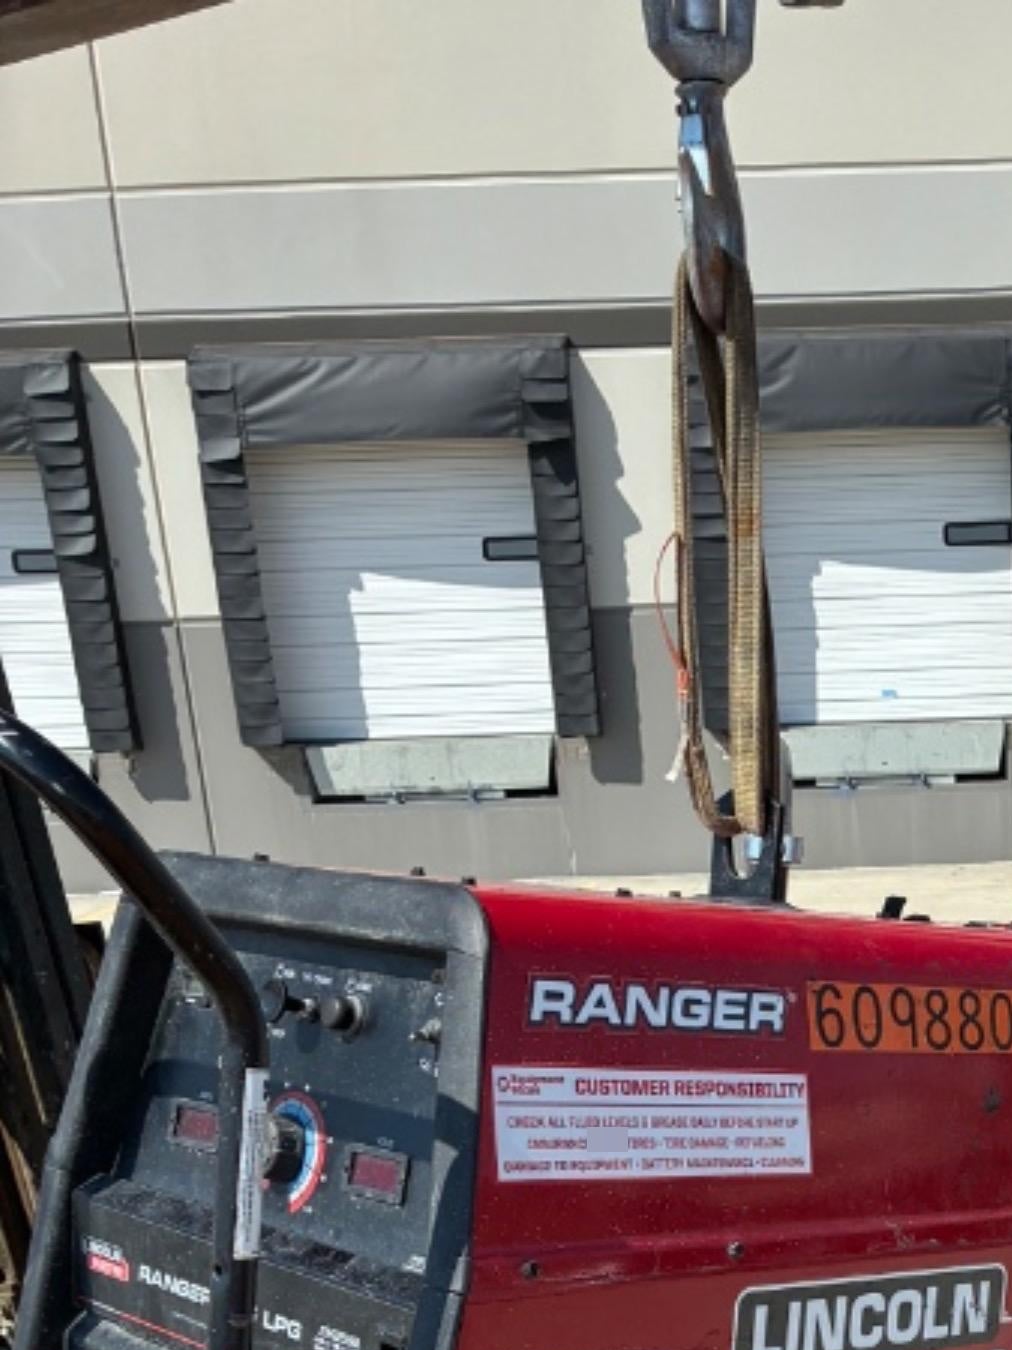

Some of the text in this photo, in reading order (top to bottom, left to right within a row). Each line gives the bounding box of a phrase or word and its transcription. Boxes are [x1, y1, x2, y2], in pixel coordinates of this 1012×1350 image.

[529, 980, 785, 1032] RANGER
[575, 1078, 805, 1099] CUSTOMER RESPONSIBILITY
[262, 1309, 303, 1342] LPG
